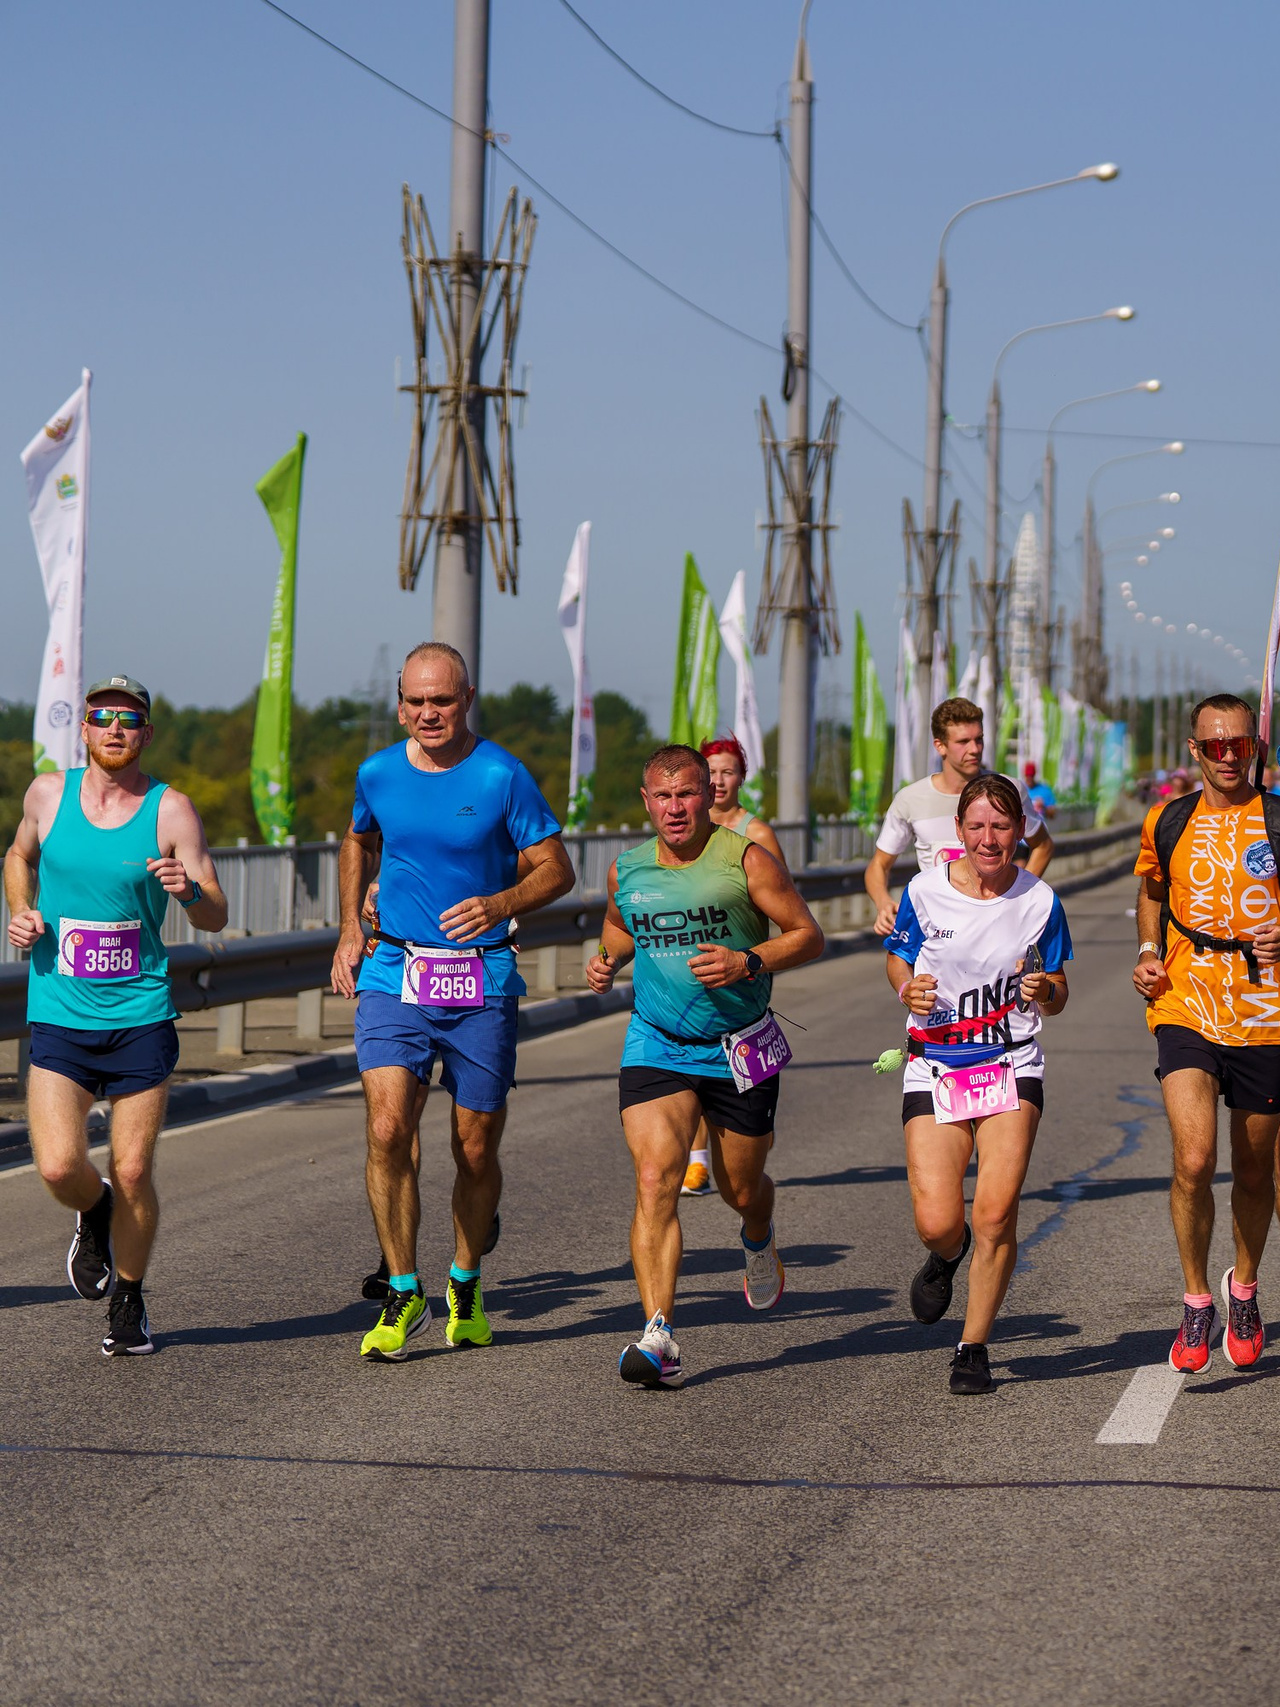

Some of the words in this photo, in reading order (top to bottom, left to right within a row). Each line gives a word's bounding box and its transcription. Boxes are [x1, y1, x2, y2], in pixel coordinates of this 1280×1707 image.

[1189, 814, 1222, 968] КЛУЖСКИЙ
[631, 905, 728, 932] НОЧЬ
[99, 936, 121, 947] ИВАН
[637, 925, 733, 949] СТРЕЛКА
[85, 948, 133, 972] 3558
[433, 962, 471, 974] НИКОЛАЙ
[429, 976, 476, 1000] 2959
[757, 1025, 776, 1048] АНДРЕЙ
[757, 1035, 787, 1072] 1469
[969, 1071, 997, 1085] ОЛЬГА
